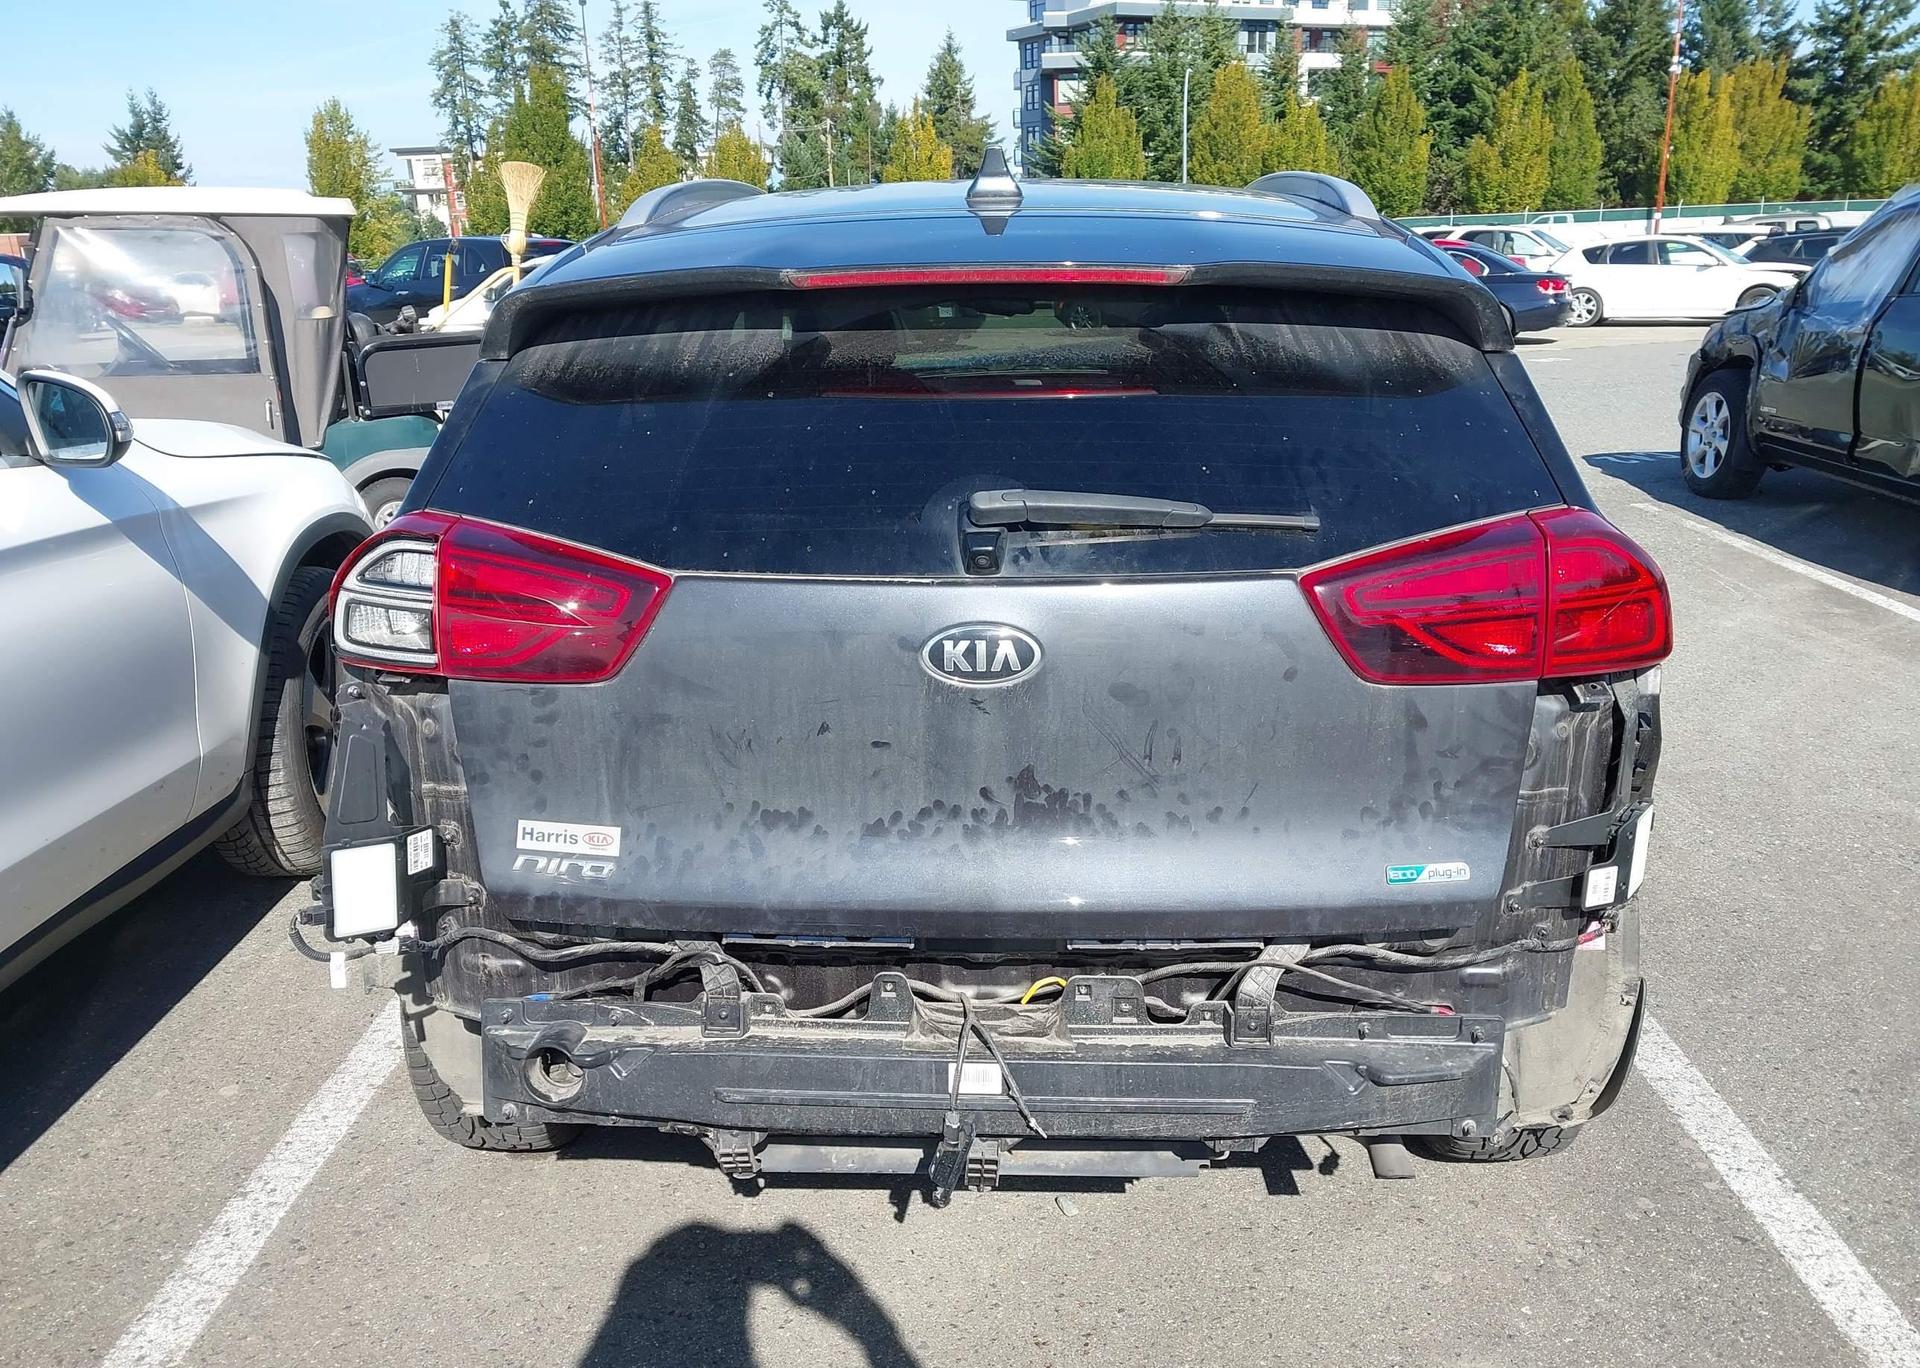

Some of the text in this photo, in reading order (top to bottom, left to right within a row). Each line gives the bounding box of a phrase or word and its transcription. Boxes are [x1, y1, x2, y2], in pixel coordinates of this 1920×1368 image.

[942, 639, 1022, 672] KIA
[521, 826, 610, 845] Harris KIA
[1428, 866, 1467, 880] plug-in
